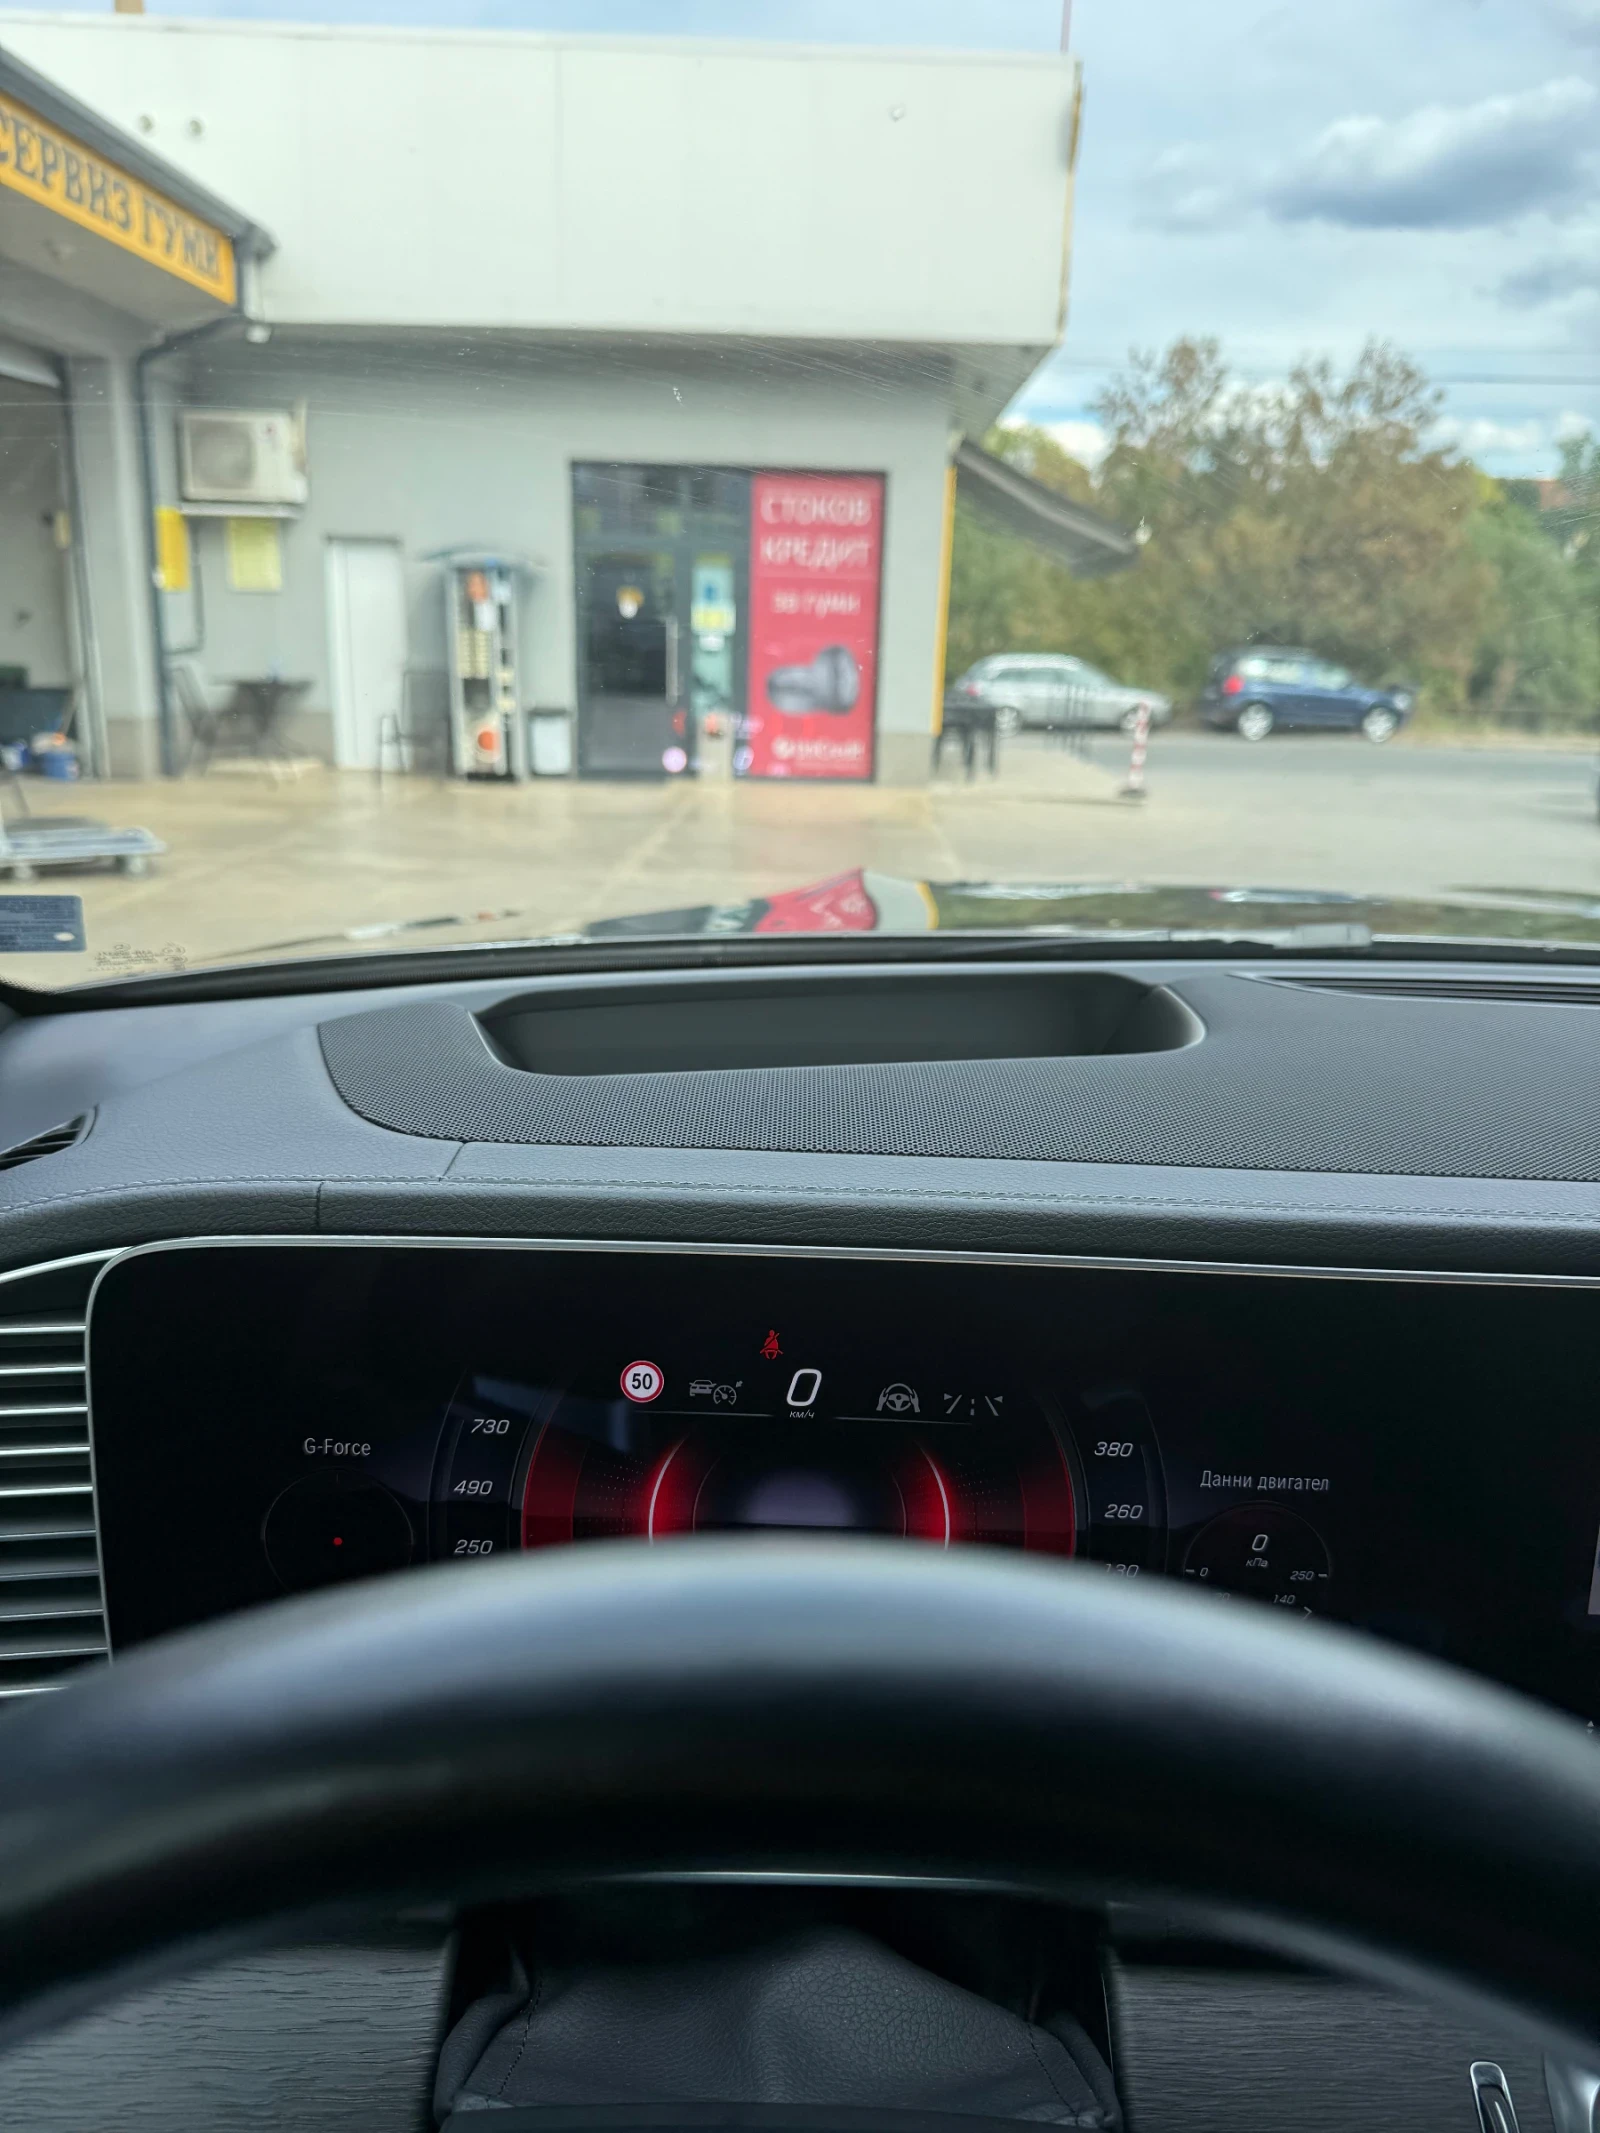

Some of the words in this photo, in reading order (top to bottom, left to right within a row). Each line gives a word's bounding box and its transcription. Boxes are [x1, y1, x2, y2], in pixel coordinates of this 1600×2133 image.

[631, 1373, 653, 1390] 50
[786, 1368, 822, 1406] 0
[472, 1419, 510, 1434] 730
[304, 1438, 371, 1456] G-Force
[1094, 1442, 1133, 1457] 380
[453, 1480, 493, 1495] 490
[1200, 1470, 1252, 1488] Данни
[1257, 1476, 1329, 1491] двигател
[1104, 1504, 1143, 1519] 260
[454, 1540, 493, 1554] 250
[1251, 1534, 1268, 1551] 0
[1245, 1557, 1268, 1568] кПа
[1199, 1567, 1208, 1577] 0
[1290, 1570, 1314, 1581] 250
[1273, 1594, 1296, 1605] 140
